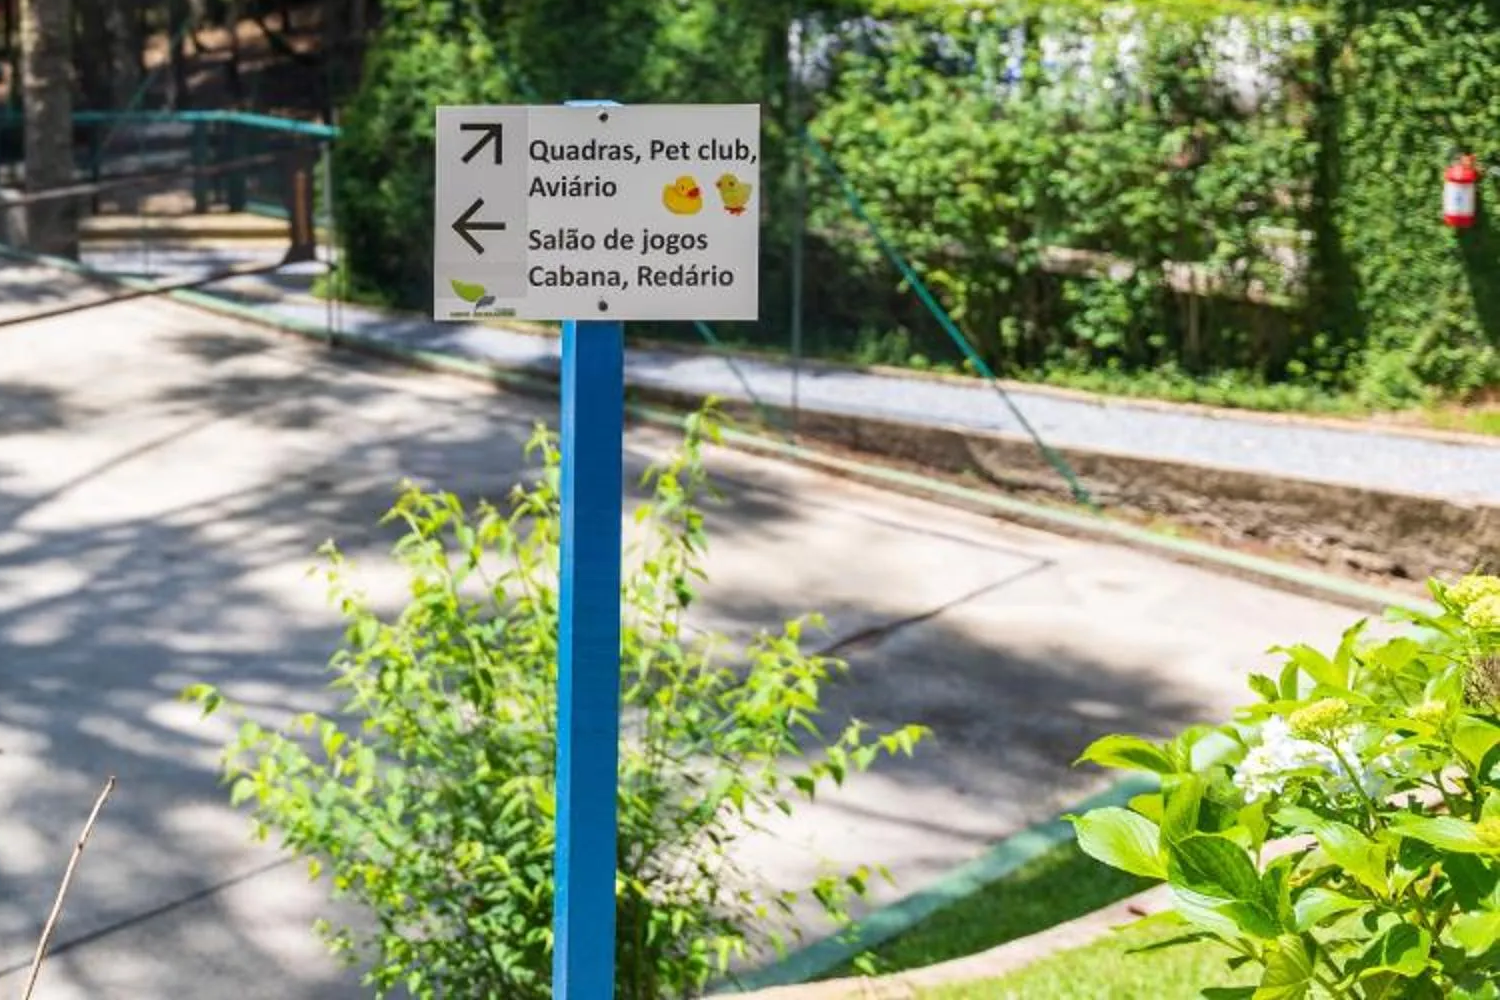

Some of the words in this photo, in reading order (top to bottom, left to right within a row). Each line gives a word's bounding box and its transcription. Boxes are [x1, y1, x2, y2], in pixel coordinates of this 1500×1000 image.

[529, 139, 641, 164] Quadras,
[650, 140, 690, 161] Pet
[698, 138, 756, 164] club,
[529, 176, 616, 197] Aviário
[529, 228, 595, 250] Salão
[604, 228, 634, 250] de
[641, 229, 708, 255] jogos
[529, 265, 628, 290] Cabana,
[638, 264, 733, 286] Redário
